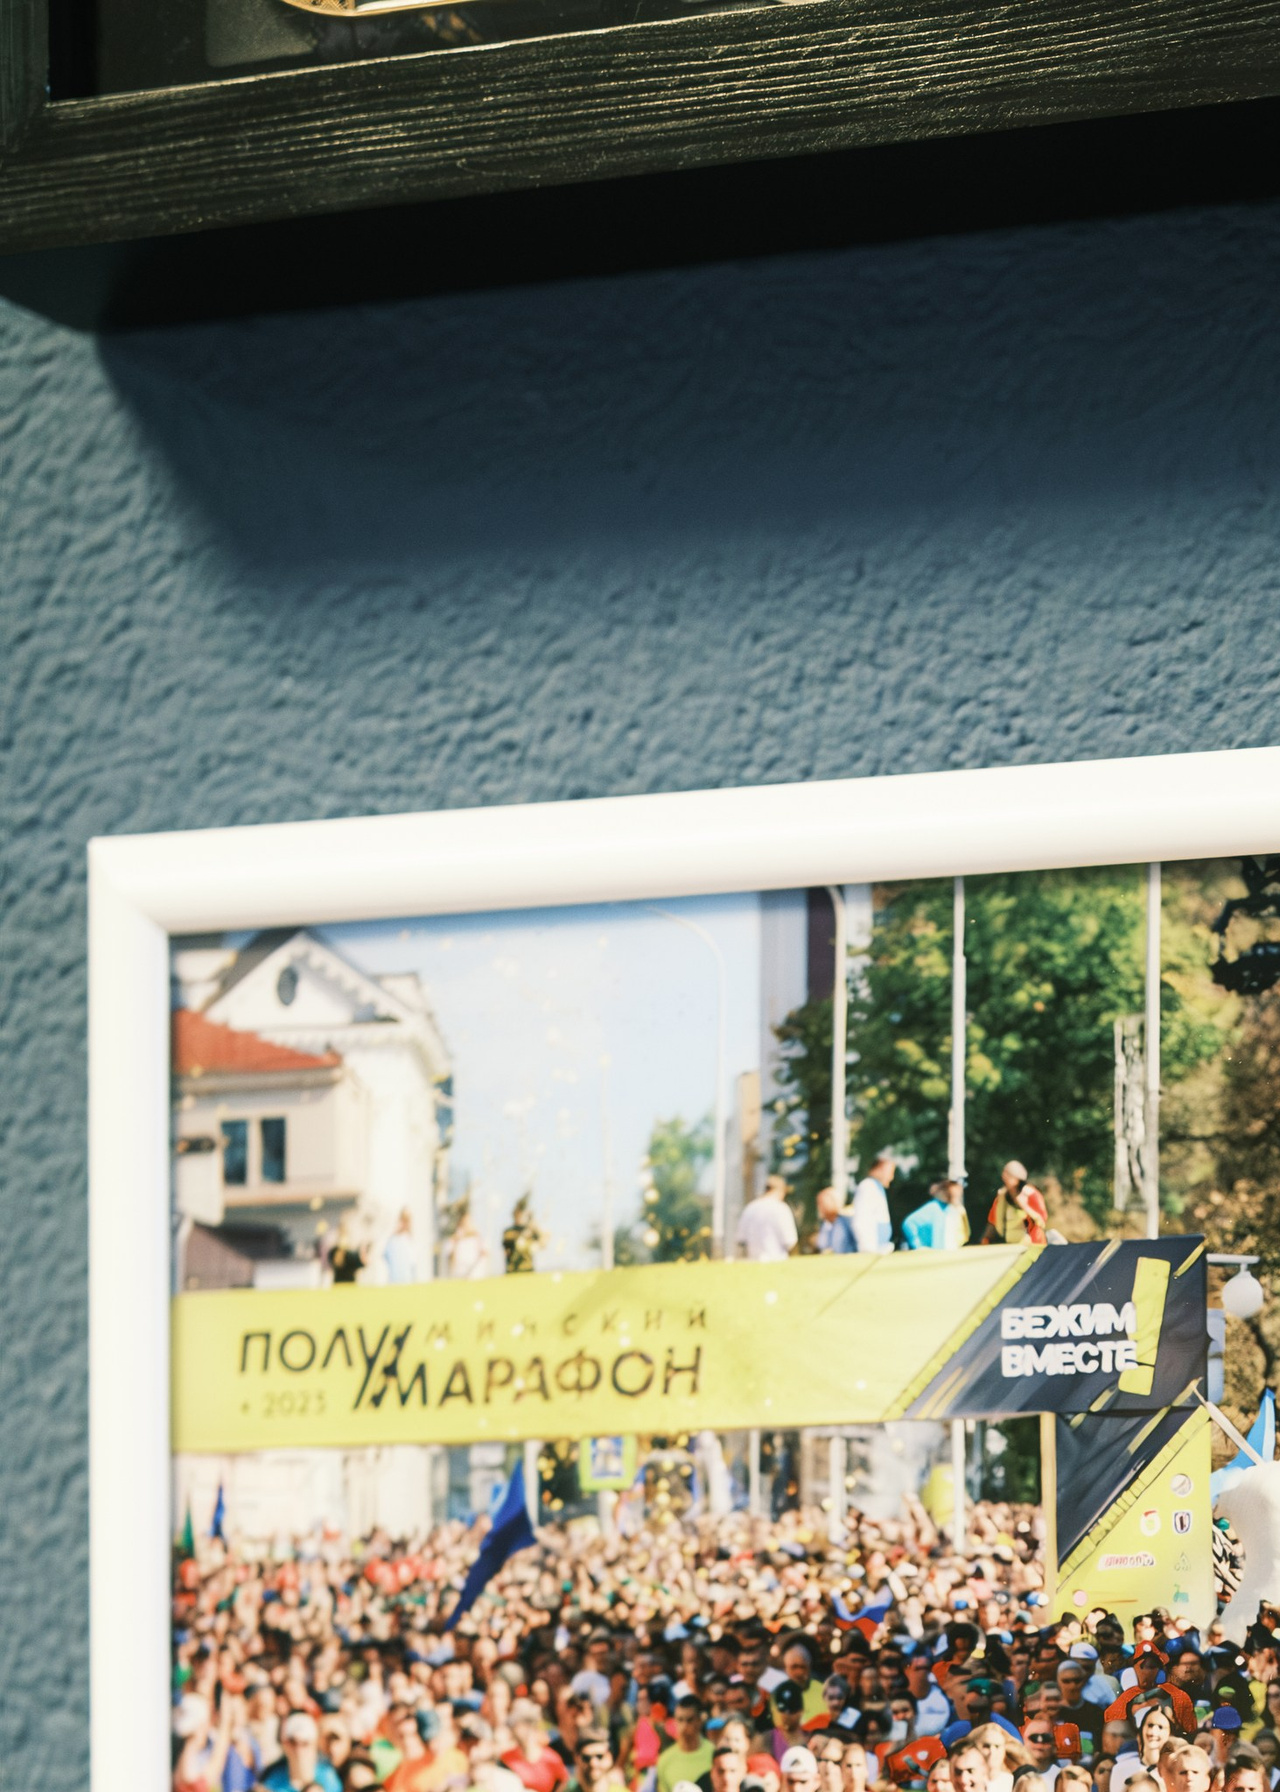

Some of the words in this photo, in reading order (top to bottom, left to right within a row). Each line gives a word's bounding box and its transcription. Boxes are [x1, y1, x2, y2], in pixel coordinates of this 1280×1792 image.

[1001, 1301, 1137, 1339] БЕЖИМ
[240, 1325, 391, 1410] ПОЛУ
[1002, 1340, 1138, 1377] ВМЕСТЕ
